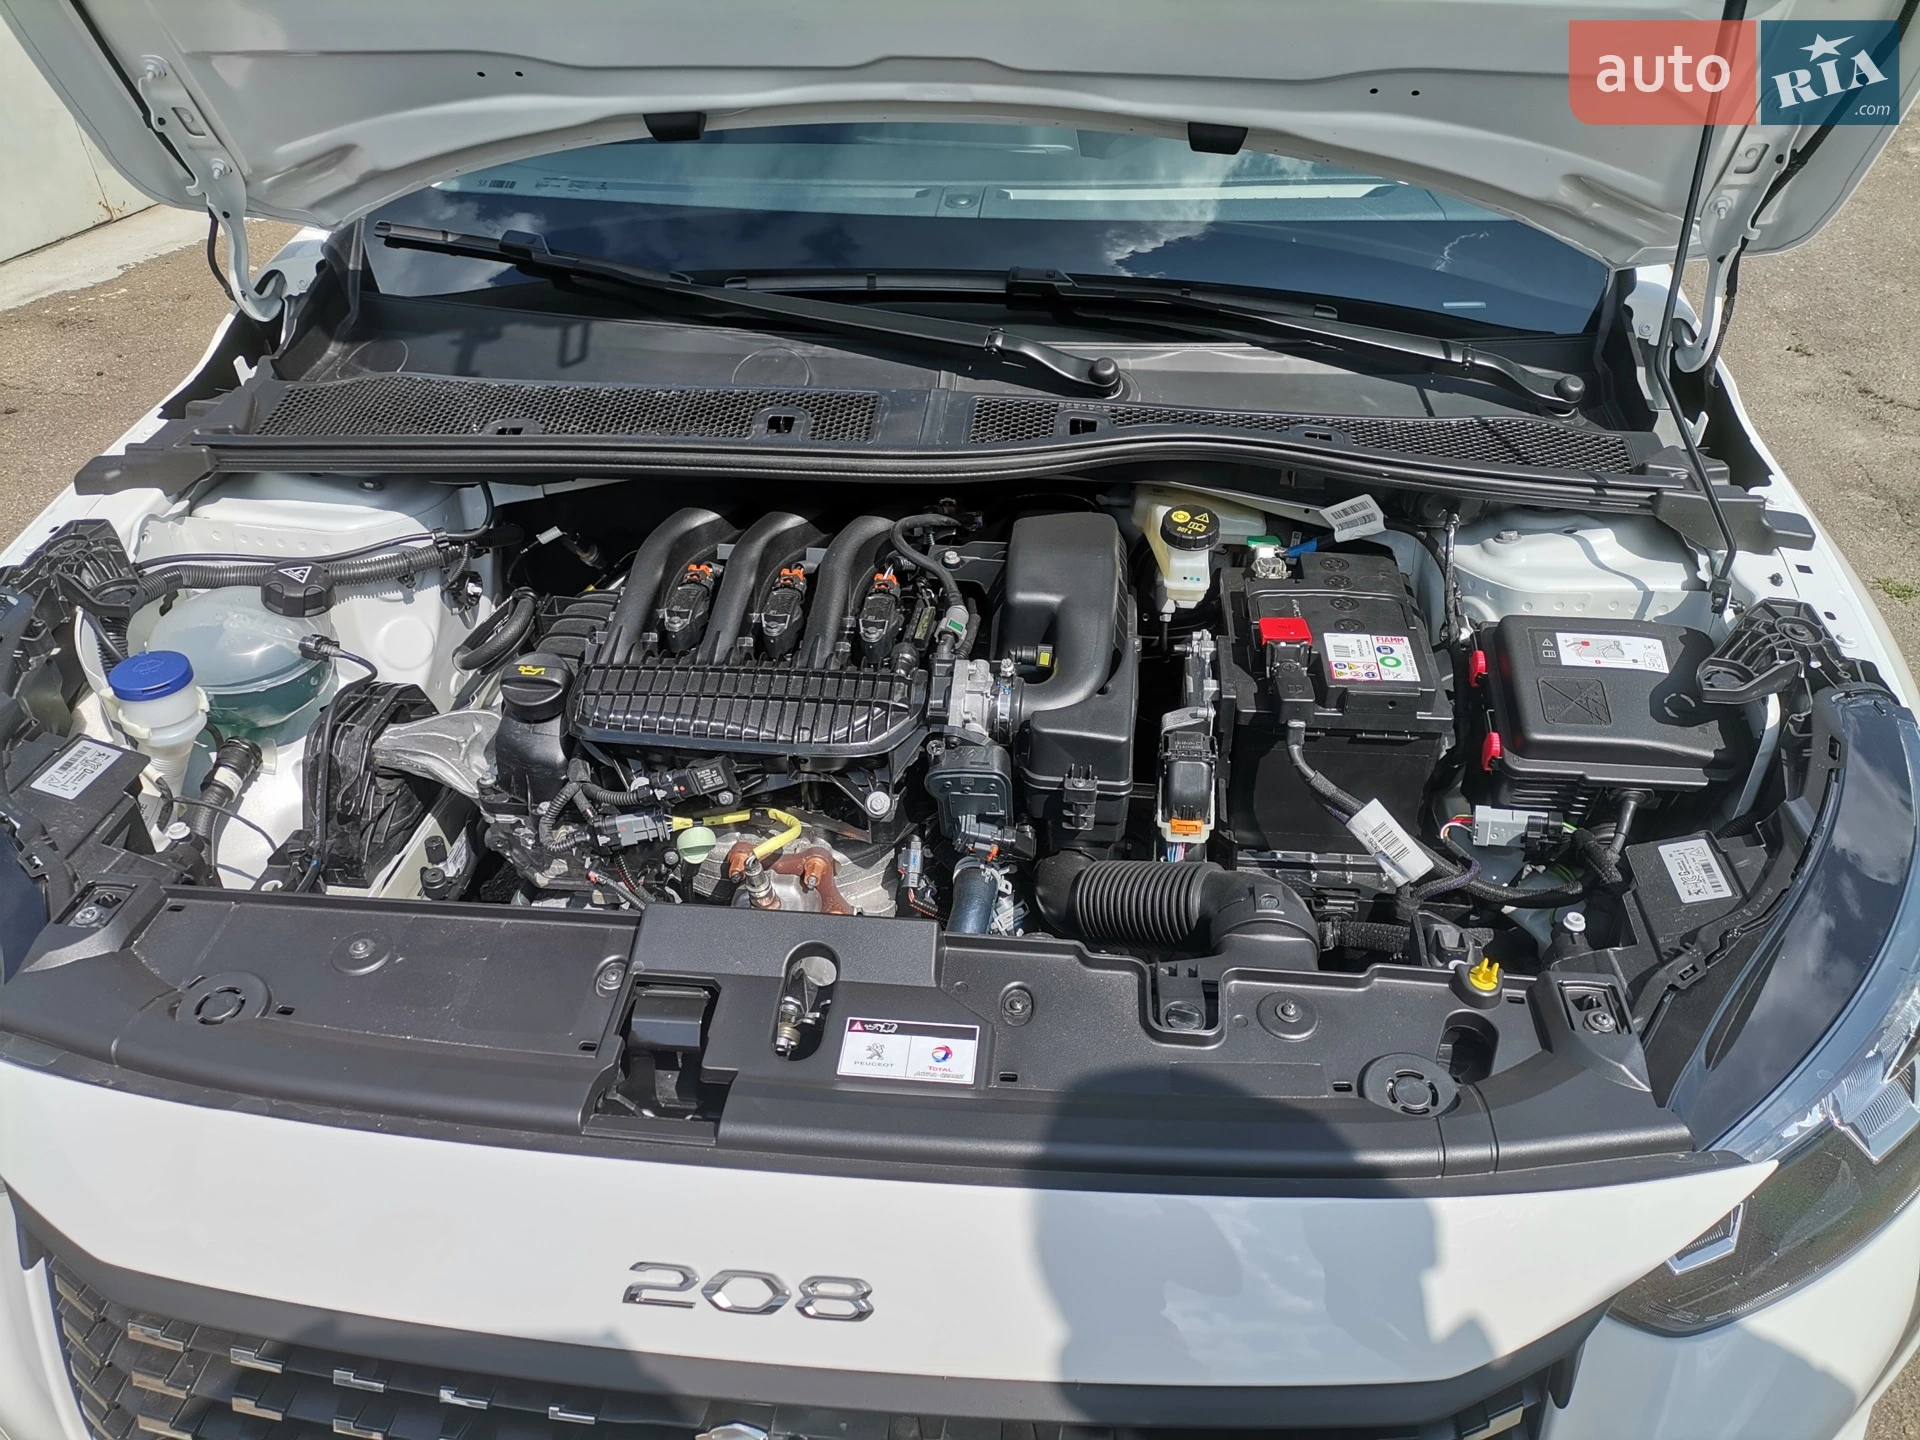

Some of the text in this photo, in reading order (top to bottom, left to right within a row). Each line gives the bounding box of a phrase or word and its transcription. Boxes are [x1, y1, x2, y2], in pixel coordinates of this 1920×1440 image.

[1375, 636, 1405, 644] FIAMM
[853, 1060, 894, 1068] PEUGEOT
[621, 1261, 875, 1322] 208
